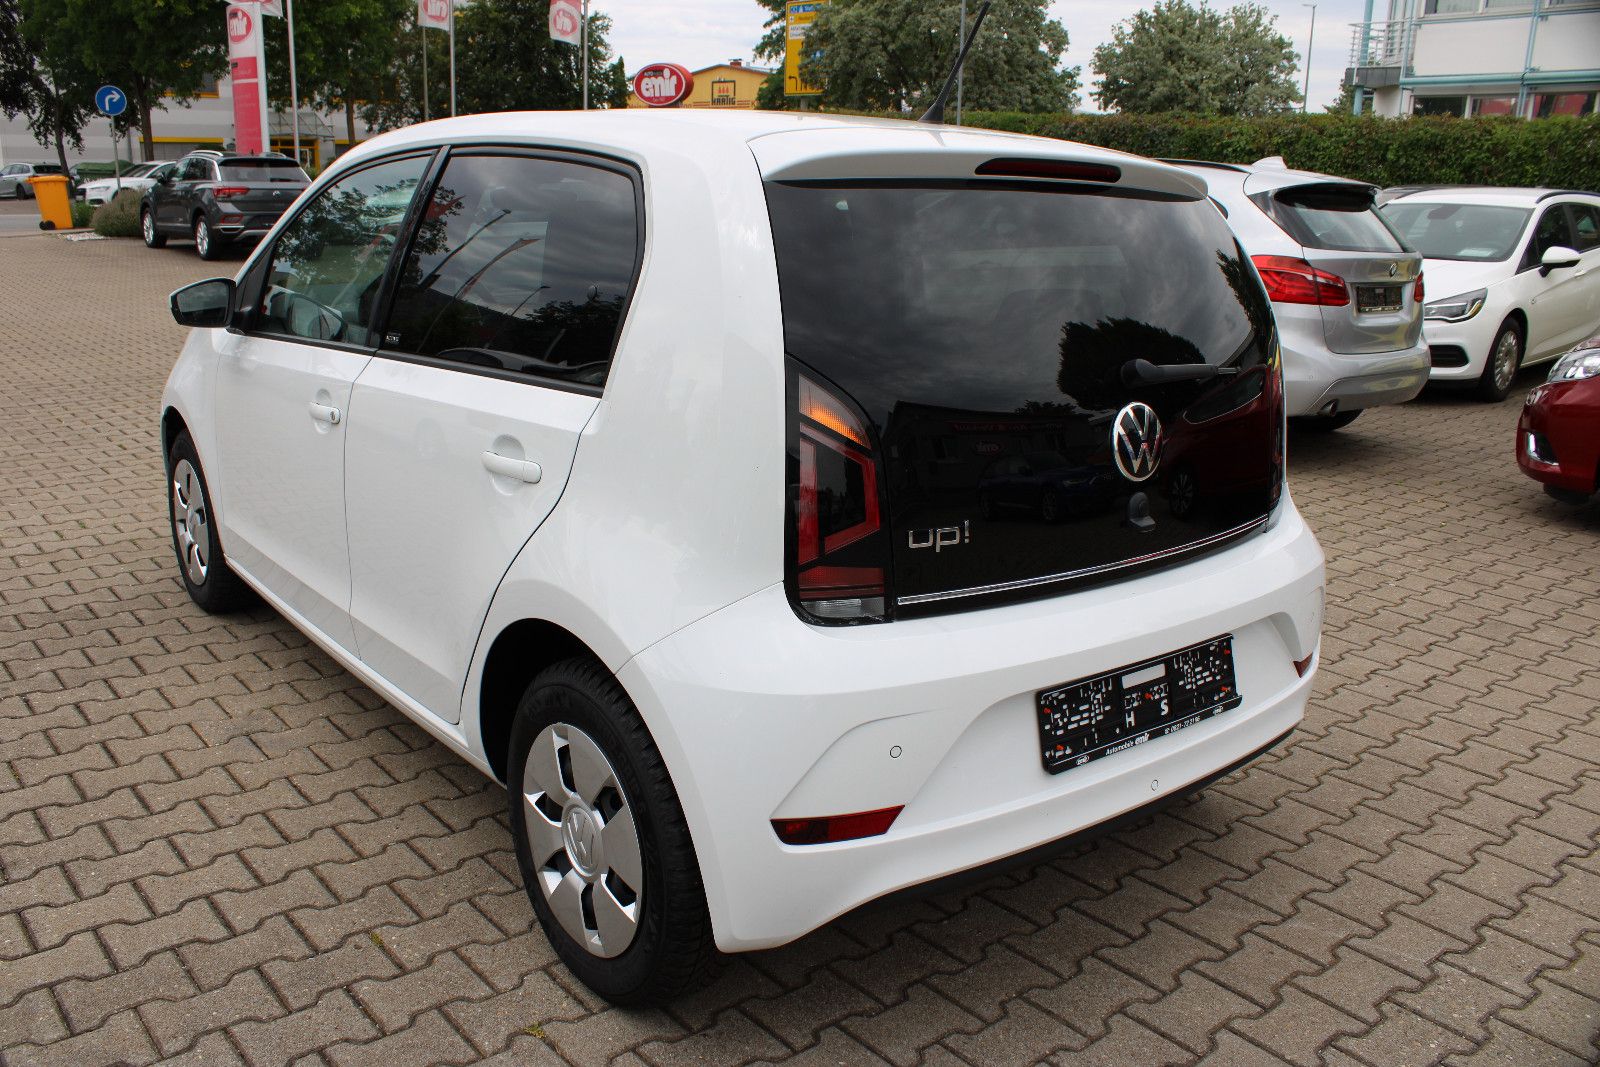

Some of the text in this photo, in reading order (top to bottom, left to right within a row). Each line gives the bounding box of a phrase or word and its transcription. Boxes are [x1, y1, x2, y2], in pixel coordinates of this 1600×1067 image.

[640, 68, 678, 97] emir
[908, 519, 970, 553] up!
[1160, 698, 1169, 716] S
[1125, 711, 1136, 728] H
